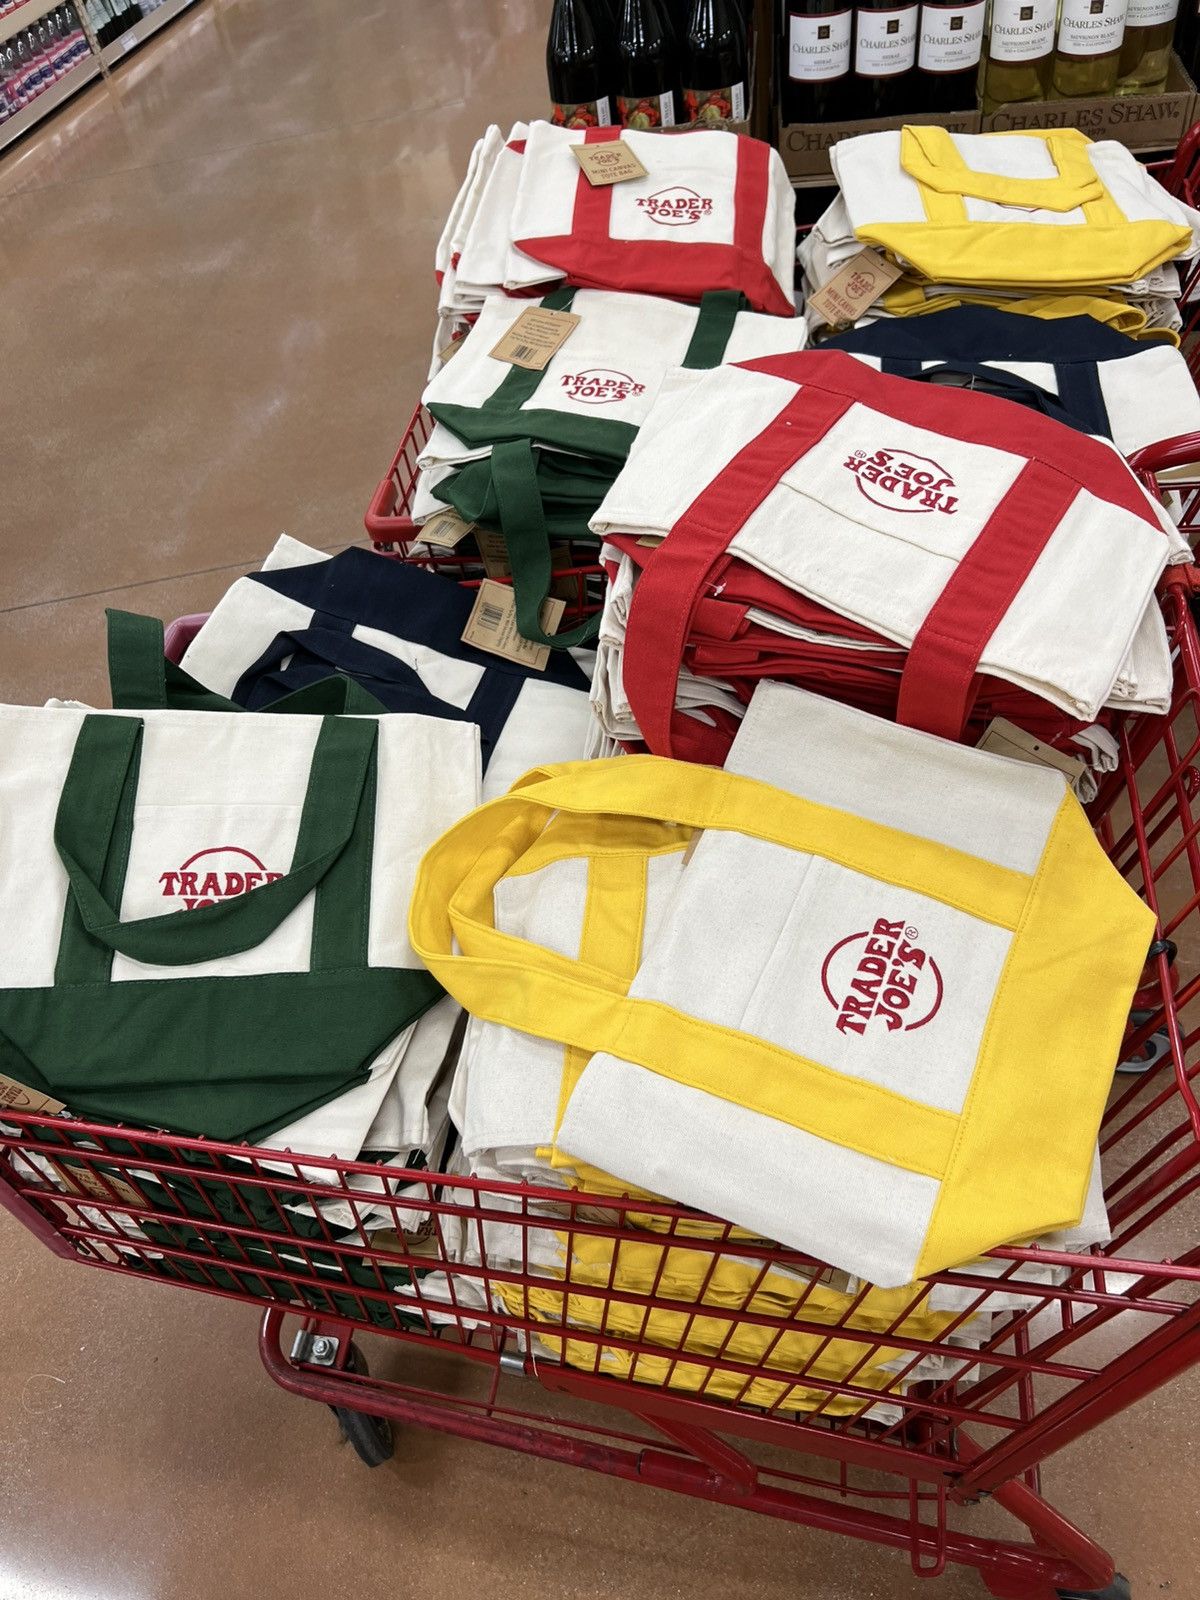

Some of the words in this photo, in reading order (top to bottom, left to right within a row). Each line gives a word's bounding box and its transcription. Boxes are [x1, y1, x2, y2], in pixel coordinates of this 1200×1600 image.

[993, 24, 1033, 35] CHARLES
[1063, 17, 1103, 29] CHARLES
[860, 38, 899, 49] CHARLES
[923, 33, 963, 45] CHARLES
[792, 42, 830, 54] CHARLES
[636, 198, 713, 211] TRADER
[643, 209, 701, 221] JOE'S
[560, 374, 646, 393] TRADER
[566, 386, 630, 400] JOE'S
[866, 450, 956, 491] JOE'S
[842, 455, 960, 515] TRADER
[835, 917, 906, 1036] TRADER
[874, 939, 927, 1032] JOE'S
